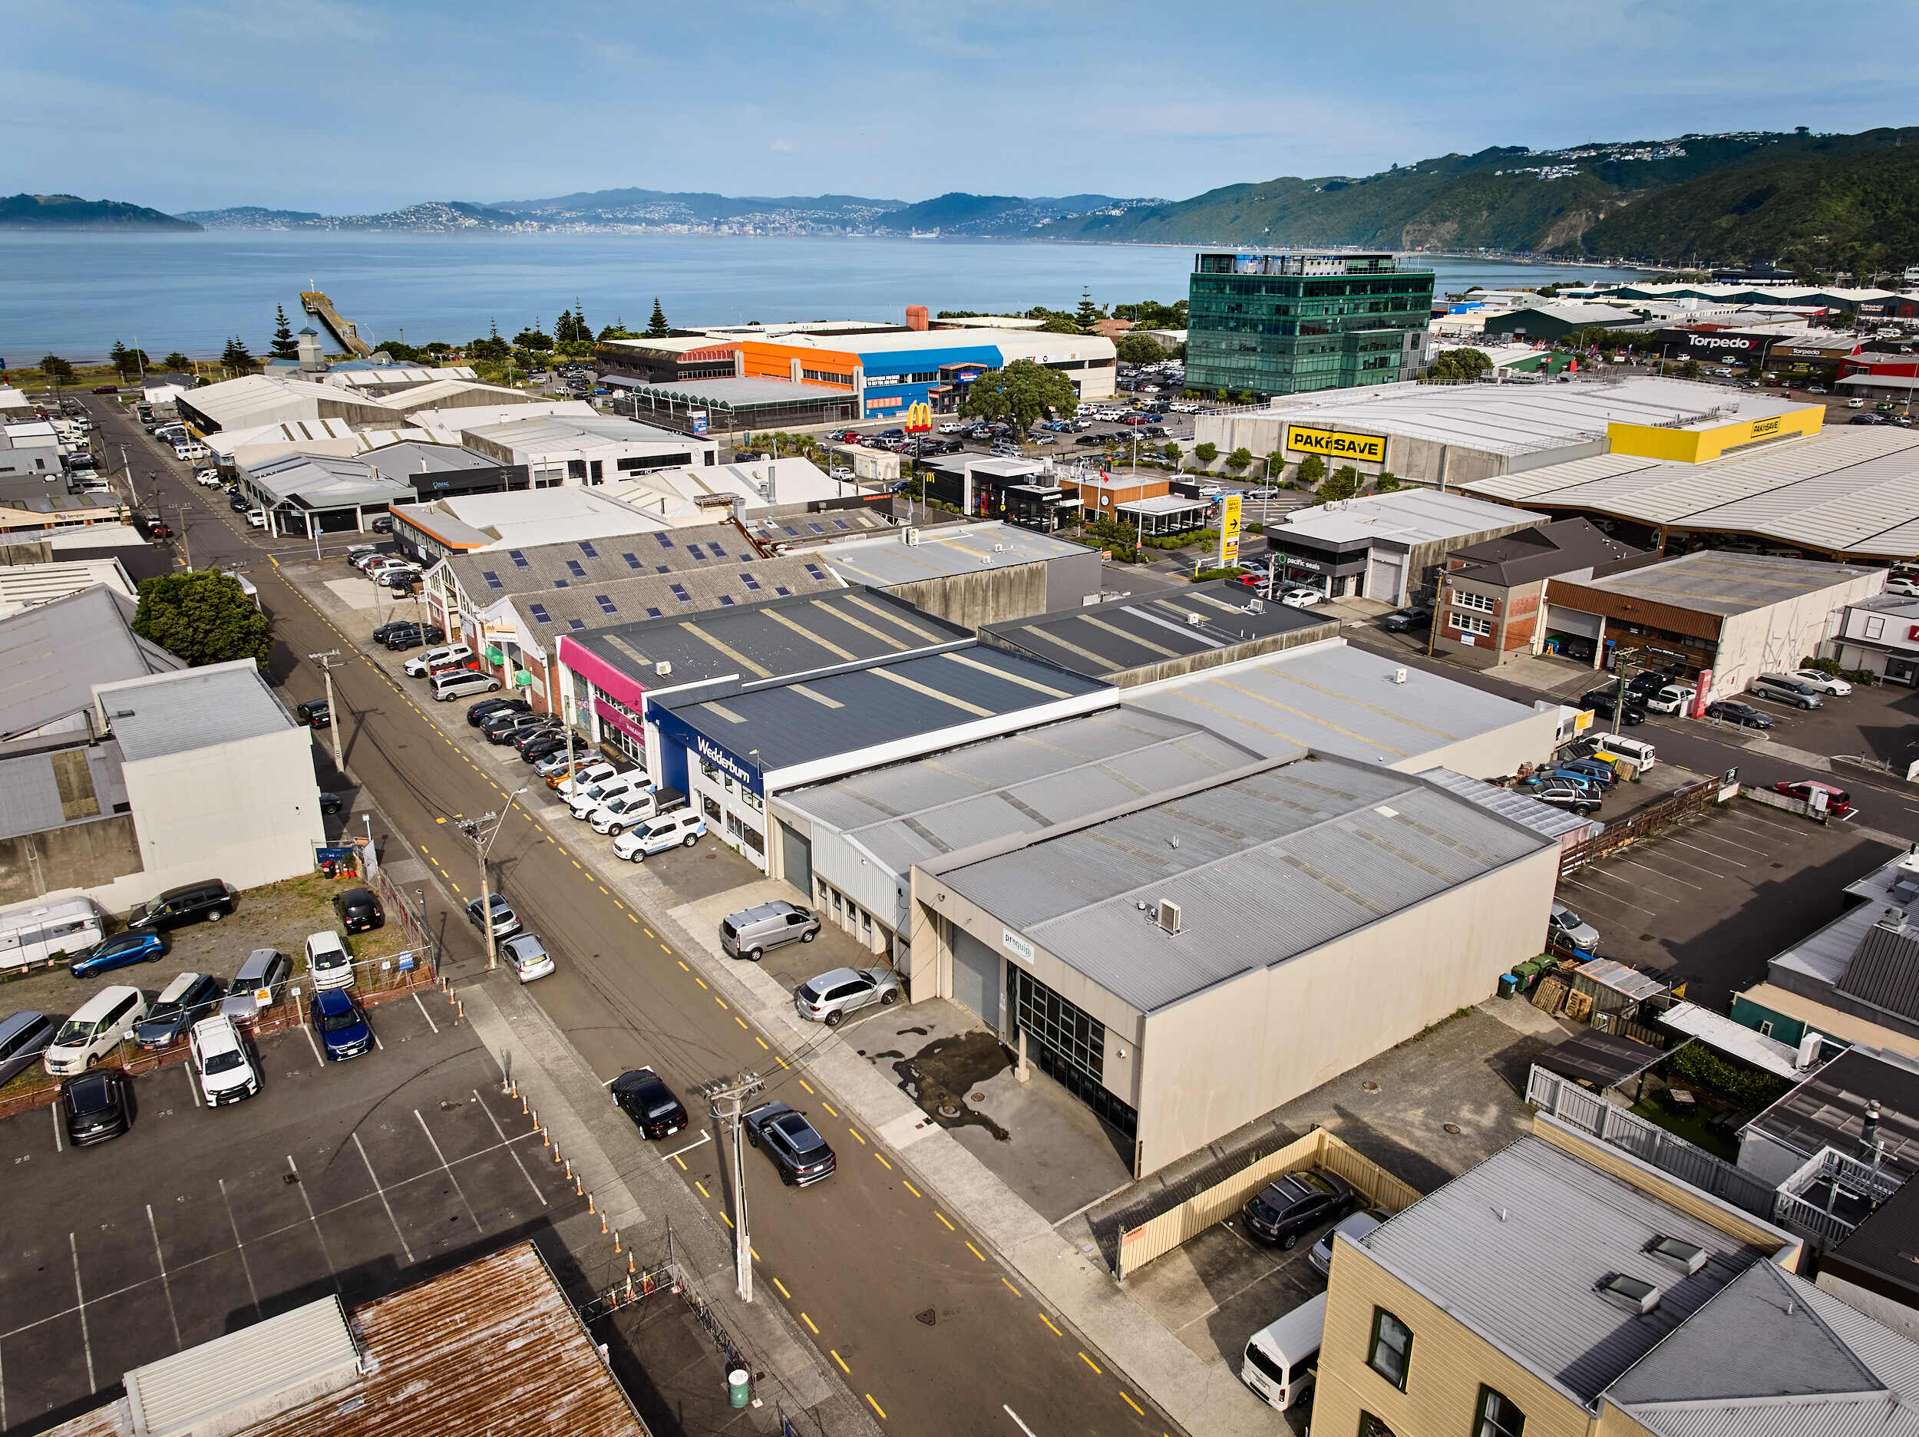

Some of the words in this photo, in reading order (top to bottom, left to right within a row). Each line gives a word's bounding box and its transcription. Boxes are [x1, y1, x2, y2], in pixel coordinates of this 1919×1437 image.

[1688, 334, 1758, 350] Torpedo7
[1287, 557, 1306, 567] pacific
[697, 735, 750, 784] Wedderburn
